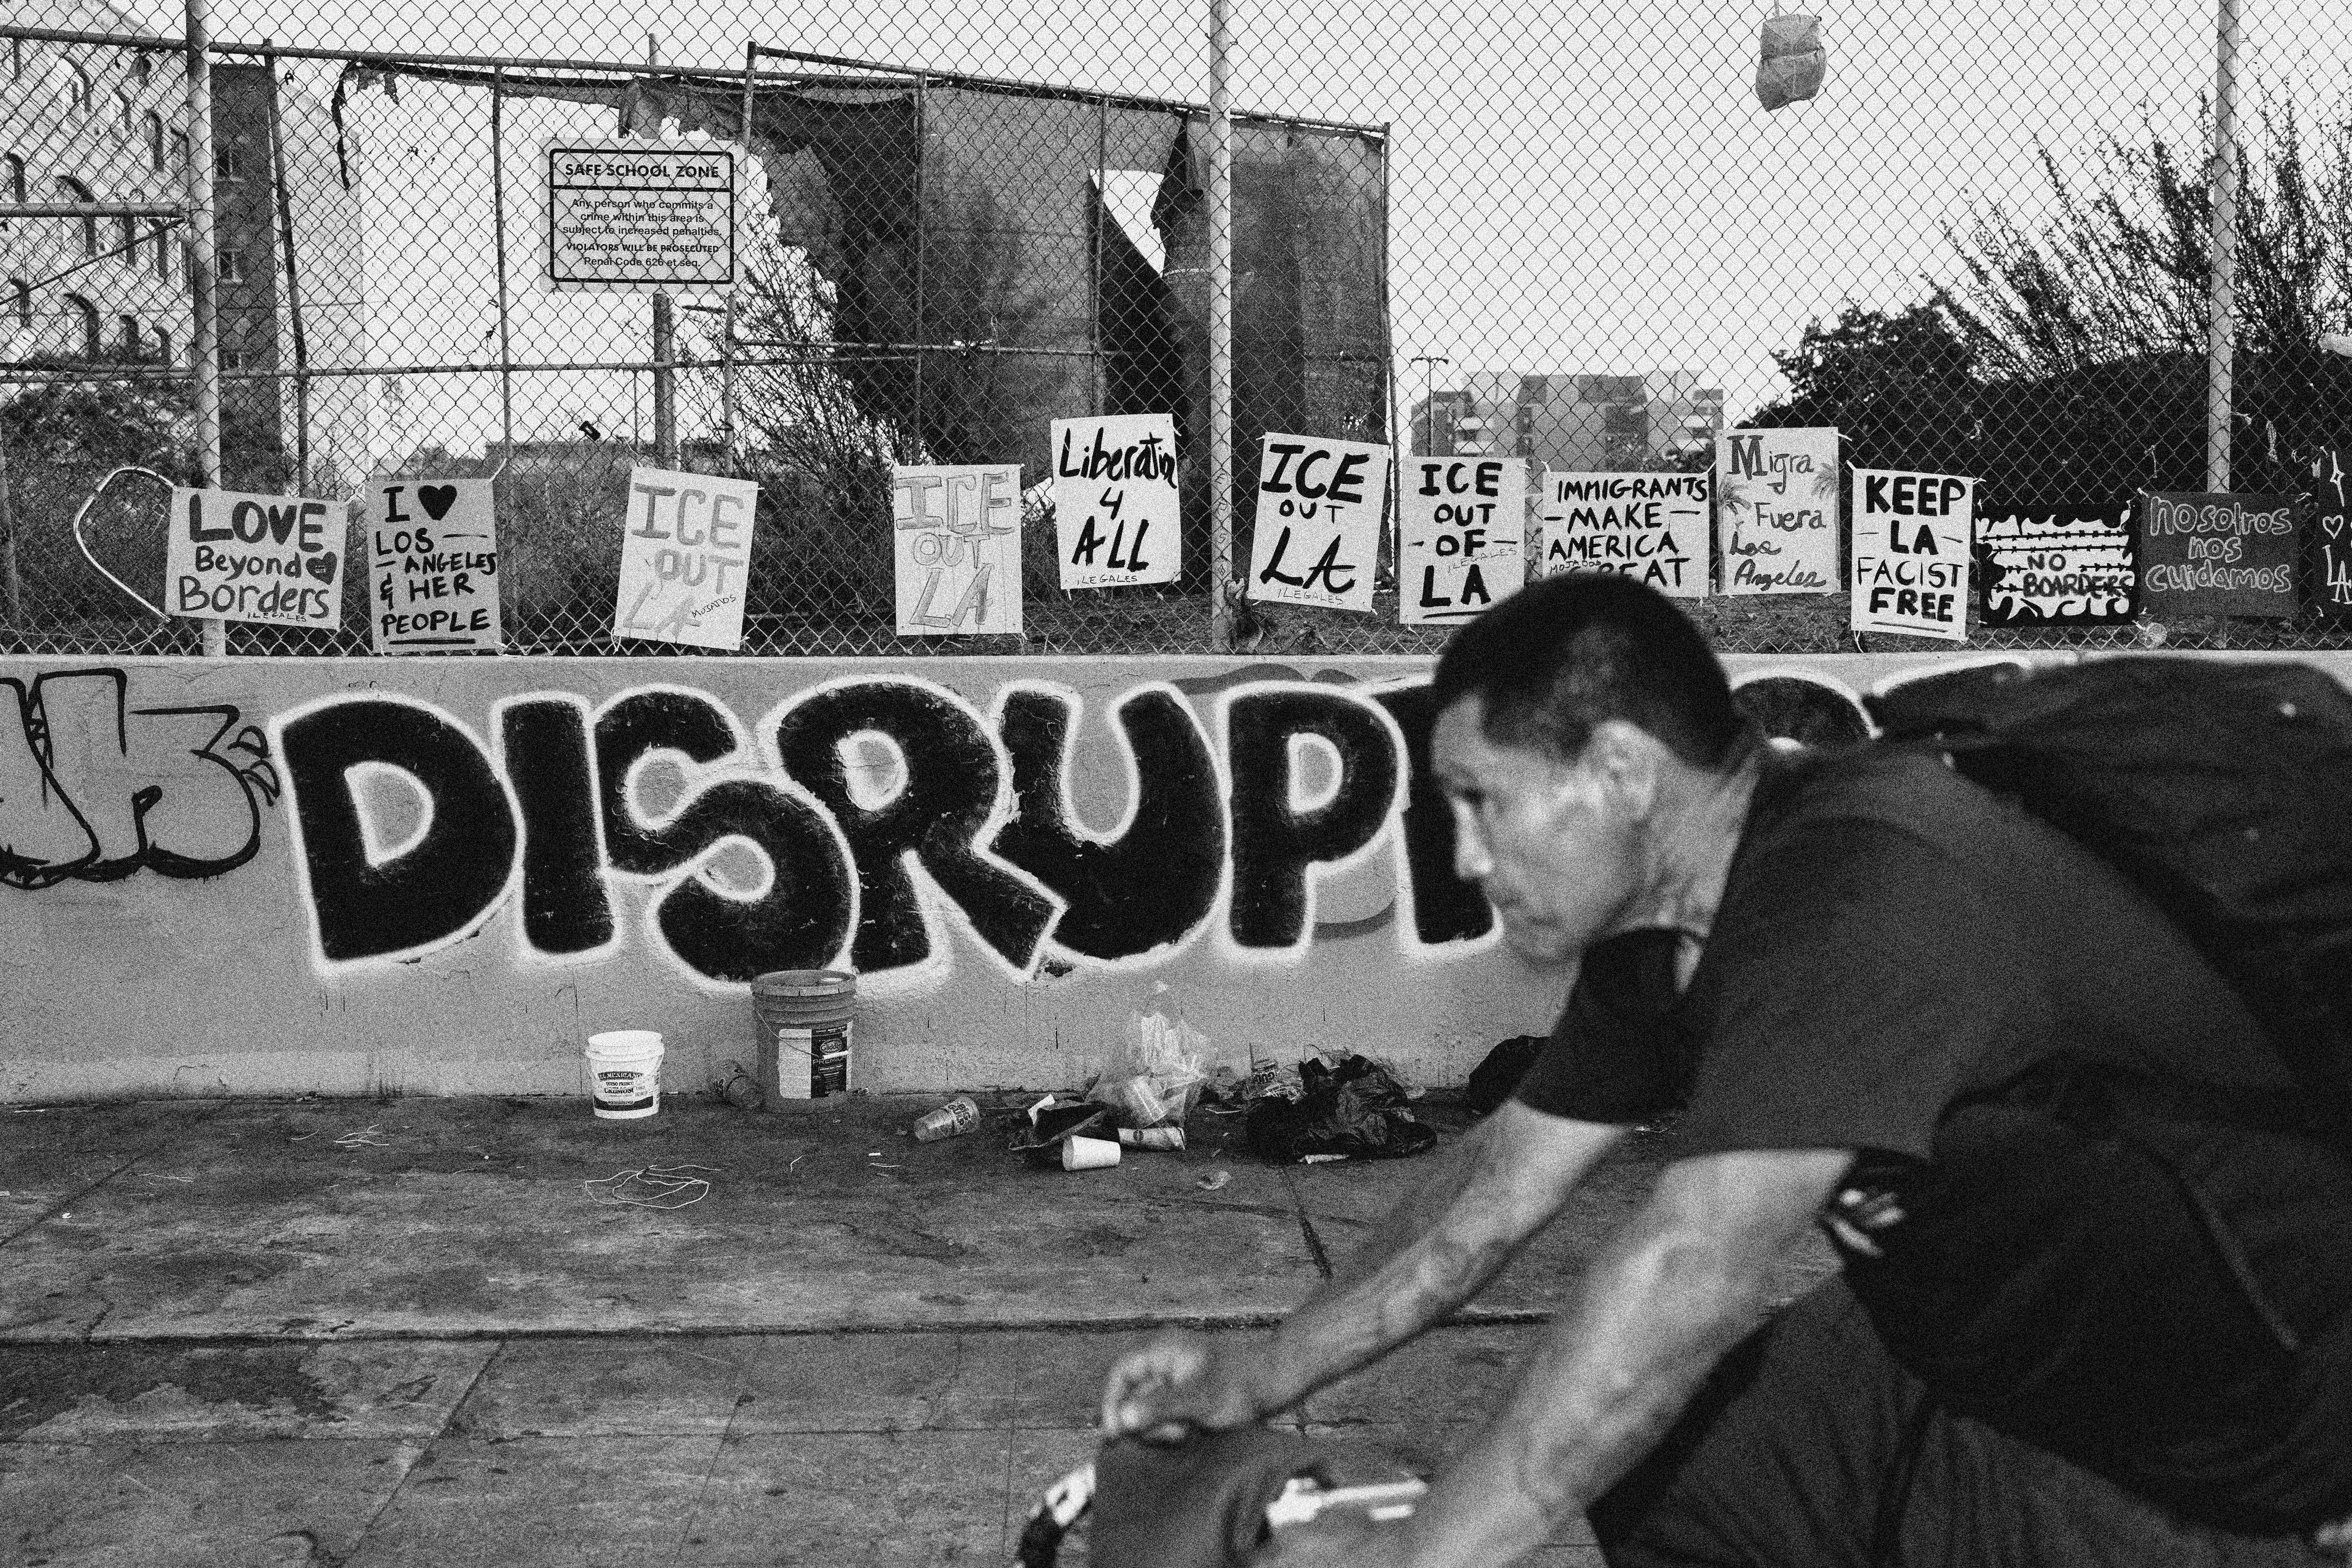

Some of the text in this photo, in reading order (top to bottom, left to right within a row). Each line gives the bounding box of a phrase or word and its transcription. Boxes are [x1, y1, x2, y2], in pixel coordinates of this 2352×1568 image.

[566, 164, 719, 178] SAFE SCHOOL ZONE
[572, 199, 591, 209] Any
[595, 201, 629, 210] person
[659, 200, 703, 209] commits
[613, 213, 644, 221] within
[648, 213, 666, 222] this
[695, 214, 704, 222] is
[563, 226, 601, 237] subject
[618, 226, 669, 235] increased
[615, 257, 642, 266] Code
[1261, 444, 1370, 504] ICE
[1419, 462, 1503, 496] ICE
[1727, 435, 1814, 494] Migra
[383, 486, 410, 522] I
[895, 471, 1015, 534] ICE
[1099, 487, 1123, 520] 4
[1558, 478, 1707, 504] IMMIGRANTS
[1866, 475, 1966, 516] KEEP
[189, 494, 326, 552] LOVE
[631, 483, 744, 549] ICE
[1279, 500, 1344, 524] OUT
[1434, 504, 1496, 526] OUT
[1567, 502, 1662, 534] MAKE
[1754, 502, 1826, 532] Fuera
[376, 528, 434, 556] LOS
[913, 532, 990, 569] OUT
[1071, 515, 1149, 572] ALL
[1436, 529, 1486, 556] OF
[1549, 531, 1679, 560] AMERICA
[1730, 532, 1782, 556] Los
[1890, 520, 1939, 555] LA
[195, 546, 301, 581] Beyond
[404, 552, 497, 575] ANGELES
[655, 549, 744, 594] OUT
[1260, 526, 1356, 594] LA
[1569, 558, 1690, 587] EAT
[1735, 559, 1826, 591] Angeles
[1857, 557, 1964, 588] FACIST
[2027, 554, 2066, 572] NO
[179, 576, 329, 618] Borders
[409, 572, 475, 601] HER
[909, 563, 995, 628] LA
[1420, 564, 1491, 607] LA
[623, 580, 701, 638] LA
[1869, 587, 1954, 622] FREE
[381, 608, 490, 637] PEOPLE
